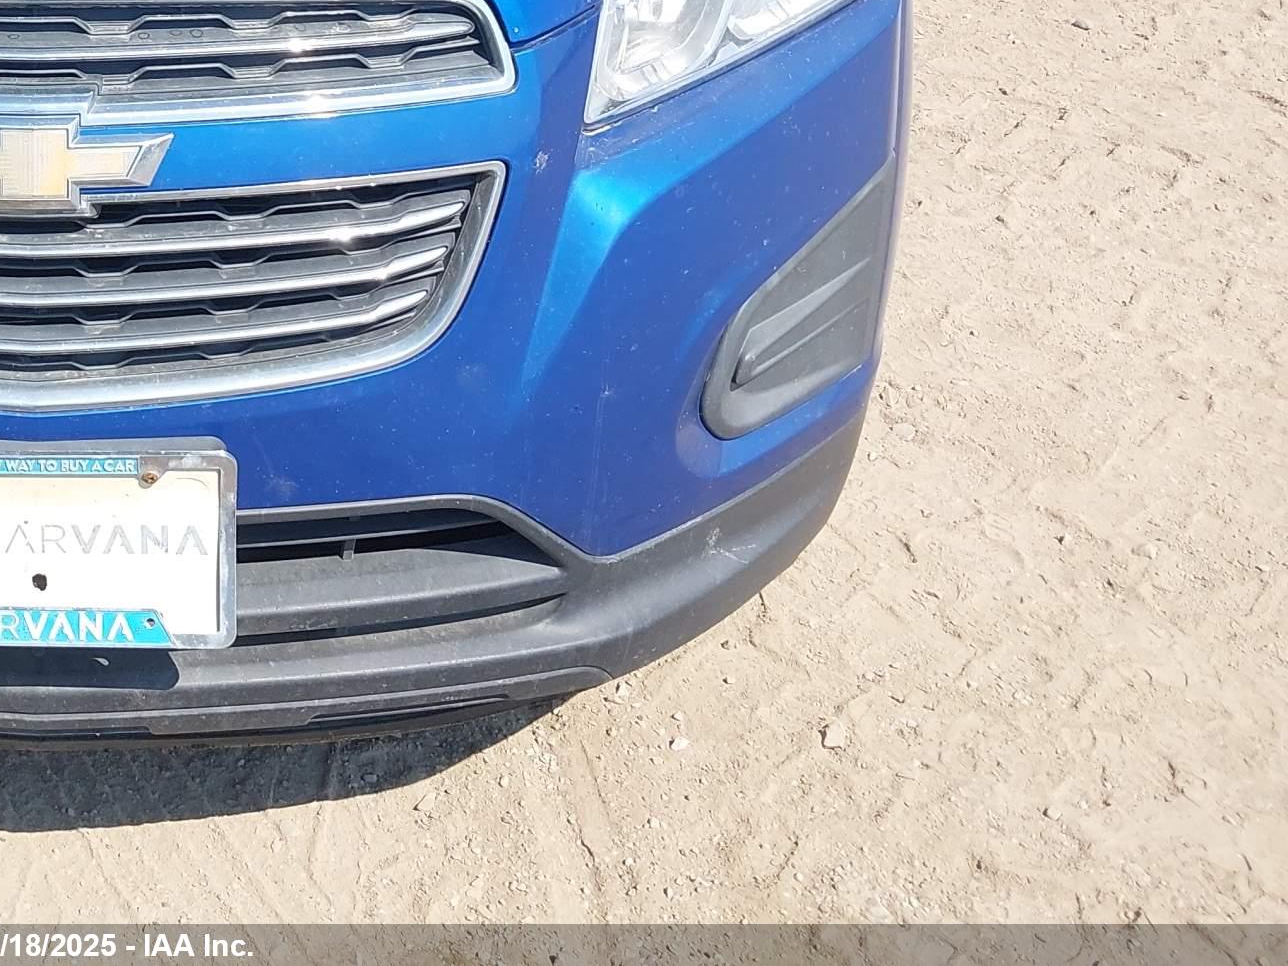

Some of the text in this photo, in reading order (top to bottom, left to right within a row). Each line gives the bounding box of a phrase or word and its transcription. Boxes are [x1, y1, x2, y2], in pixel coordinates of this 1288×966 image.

[5, 459, 36, 473] WAY
[38, 459, 58, 473] TO
[61, 459, 90, 473] BUY
[91, 460, 105, 473] A
[103, 459, 135, 473] CAR
